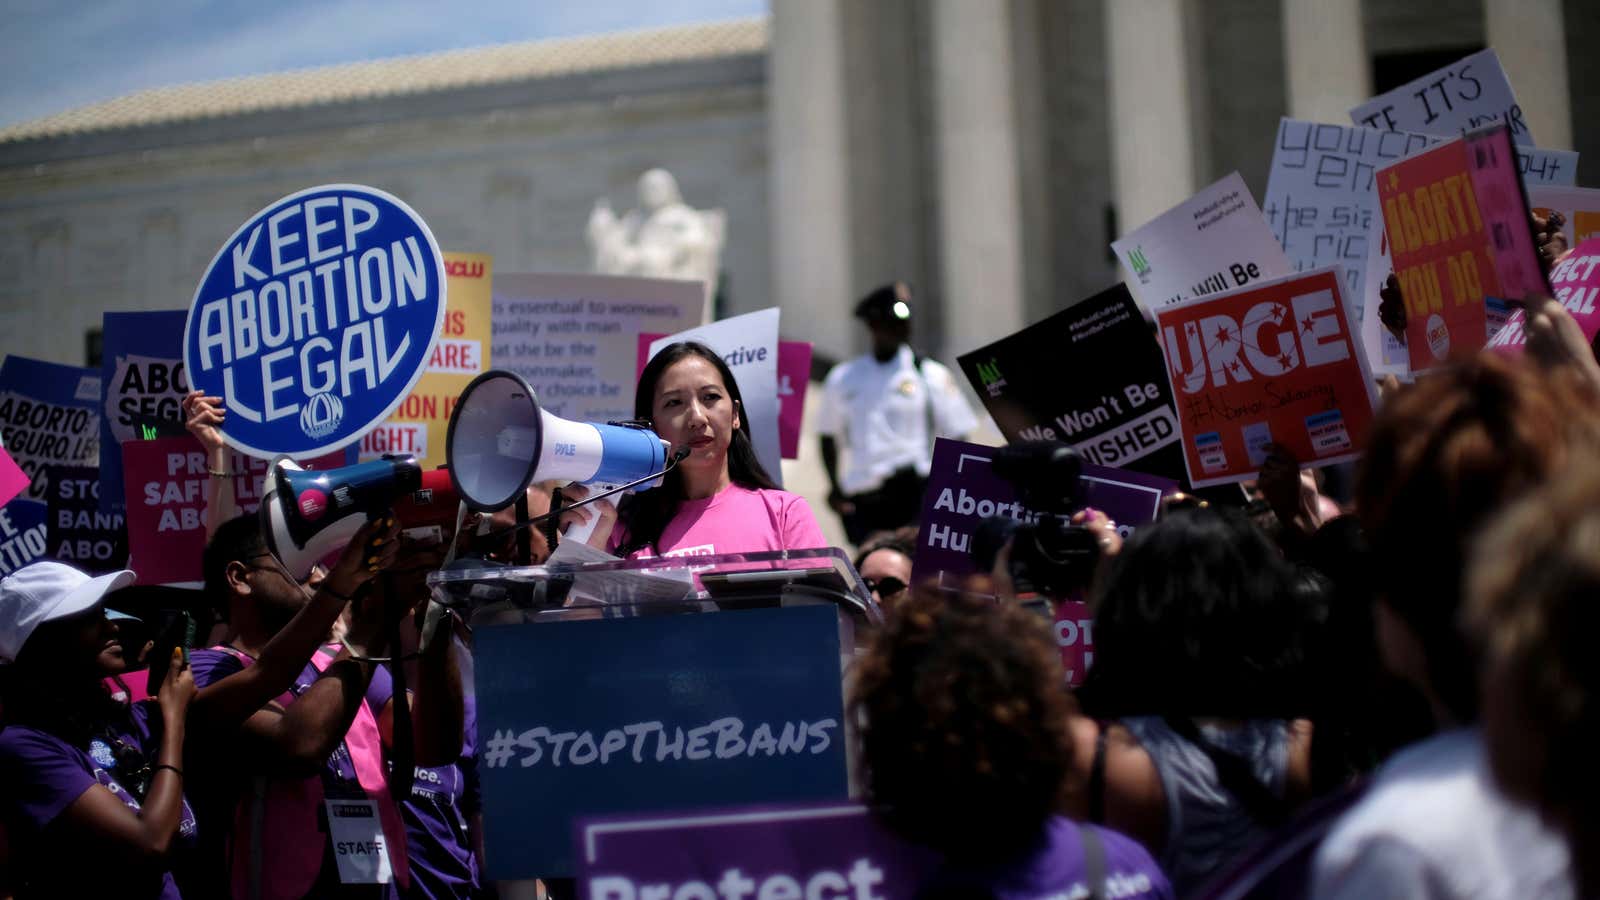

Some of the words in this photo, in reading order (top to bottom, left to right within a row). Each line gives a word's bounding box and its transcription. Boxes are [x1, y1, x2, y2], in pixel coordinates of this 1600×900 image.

[1413, 64, 1482, 125] IT'S
[233, 197, 379, 288] KEEP
[1192, 271, 1229, 297] Will
[1229, 262, 1260, 286] Be
[200, 236, 427, 371] ABORTION
[589, 301, 606, 315] to
[547, 319, 582, 334] with
[515, 342, 540, 357] she
[544, 342, 565, 357] be
[571, 341, 596, 357] the
[1164, 288, 1350, 394] URGE
[223, 316, 411, 423] LEGAL
[724, 346, 767, 367] ctive
[546, 382, 596, 397] choice
[600, 381, 620, 397] be
[388, 394, 436, 420] ION
[1019, 424, 1057, 442] We
[1056, 396, 1124, 437] Won't
[1124, 382, 1160, 408] Be
[358, 427, 422, 453] IGHT.
[554, 443, 576, 457] PYLE
[56, 539, 118, 560] ABO
[337, 842, 383, 856] STAFF
